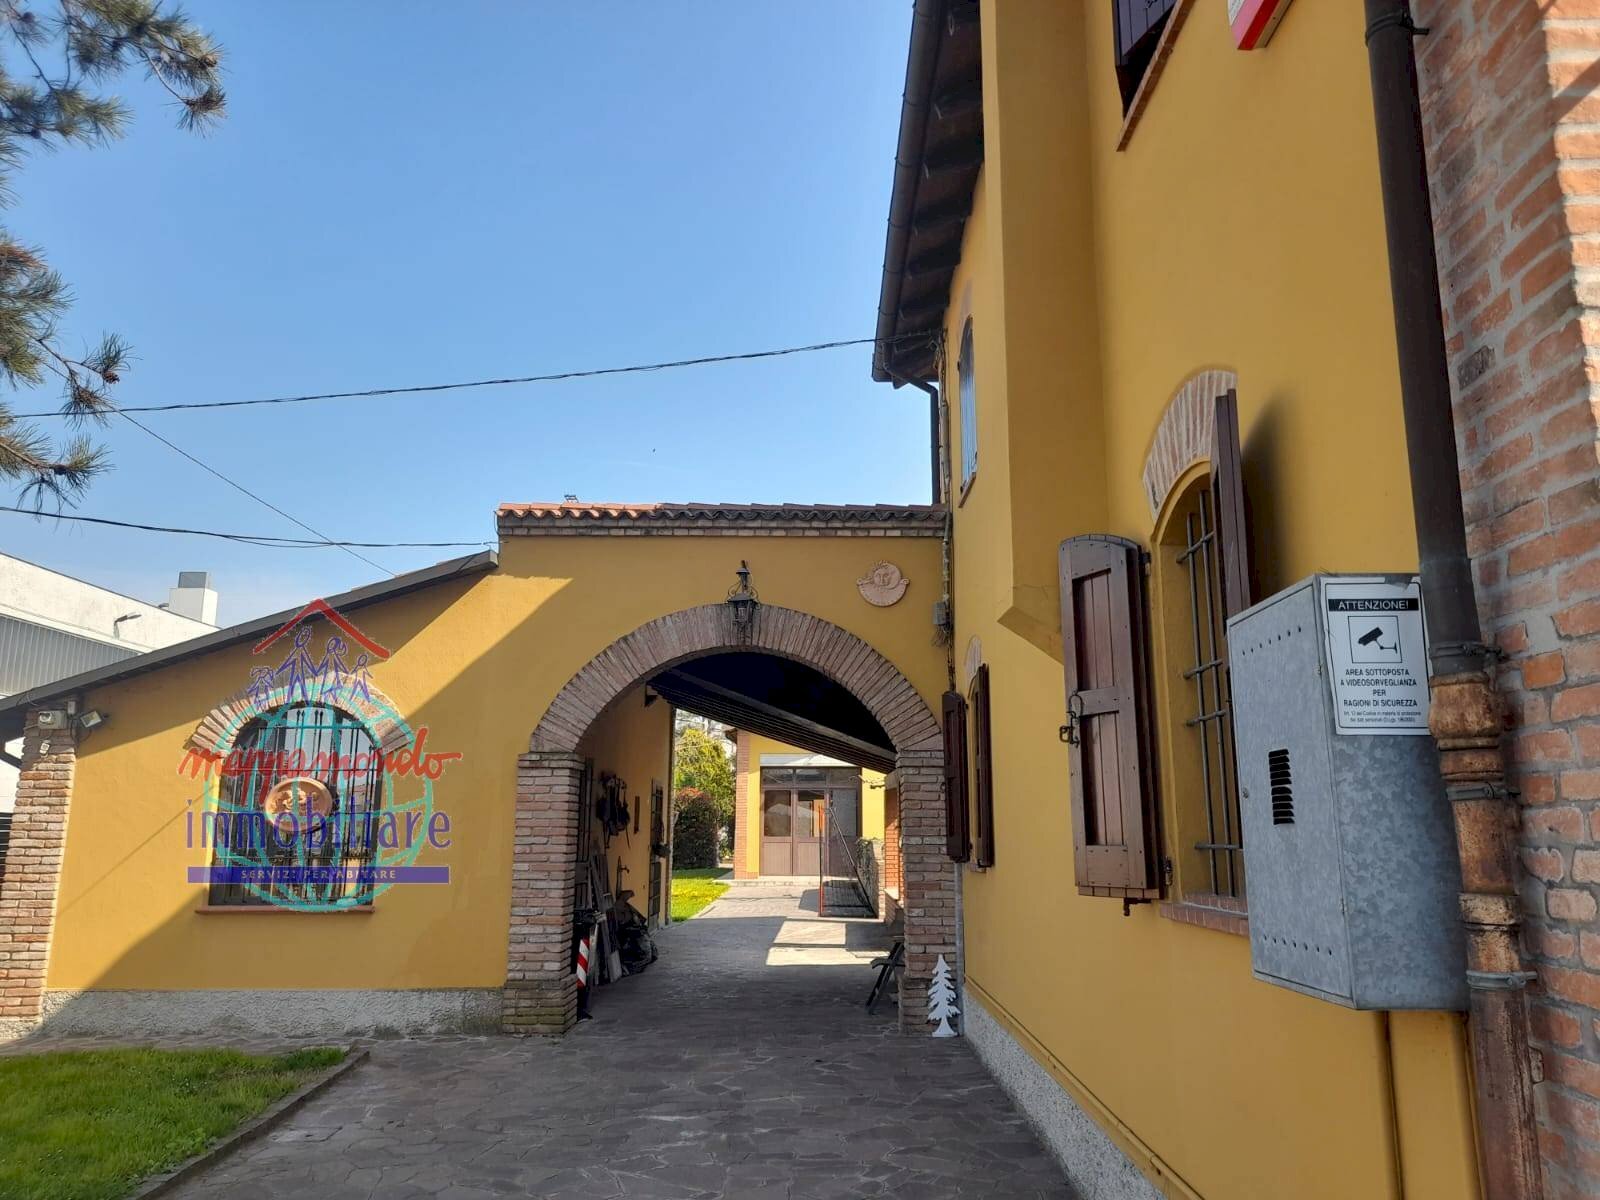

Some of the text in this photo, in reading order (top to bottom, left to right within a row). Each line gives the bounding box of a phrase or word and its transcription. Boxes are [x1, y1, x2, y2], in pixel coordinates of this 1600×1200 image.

[1338, 600, 1409, 610] ATTENZIONE!
[1345, 668, 1410, 676] AREA SOTTOPOSTA
[1346, 678, 1417, 686] VIDEOSORVEGLIANZA
[1343, 699, 1418, 707] RAGIONI DI SICUREZZA
